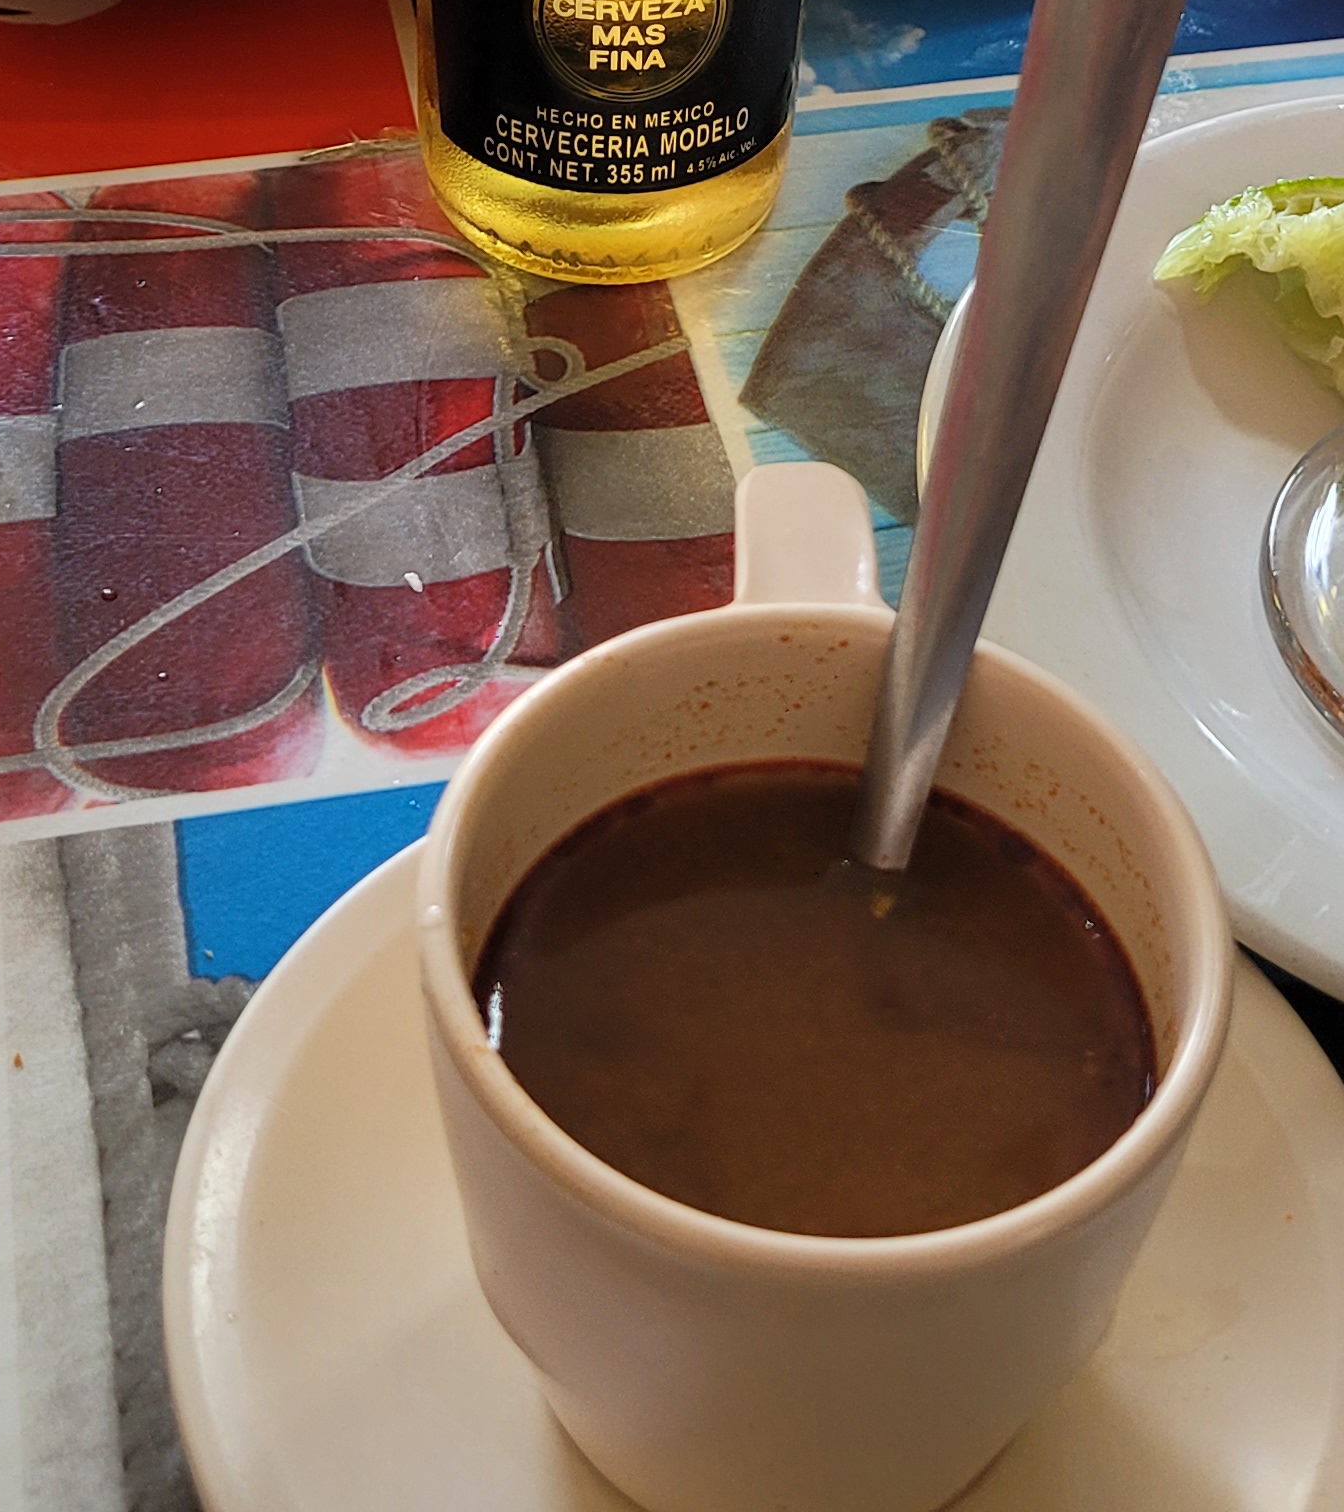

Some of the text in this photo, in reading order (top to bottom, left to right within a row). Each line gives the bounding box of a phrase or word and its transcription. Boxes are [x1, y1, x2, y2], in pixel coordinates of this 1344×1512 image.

[592, 23, 666, 46] MAS
[589, 48, 666, 71] FINA
[536, 101, 714, 130] HECHO EN MEXICO
[496, 106, 749, 159] CERVECERIA MODELO
[484, 136, 542, 175] CONT.
[549, 159, 599, 183] NET.
[607, 164, 644, 184] 355
[650, 159, 676, 182] ml
